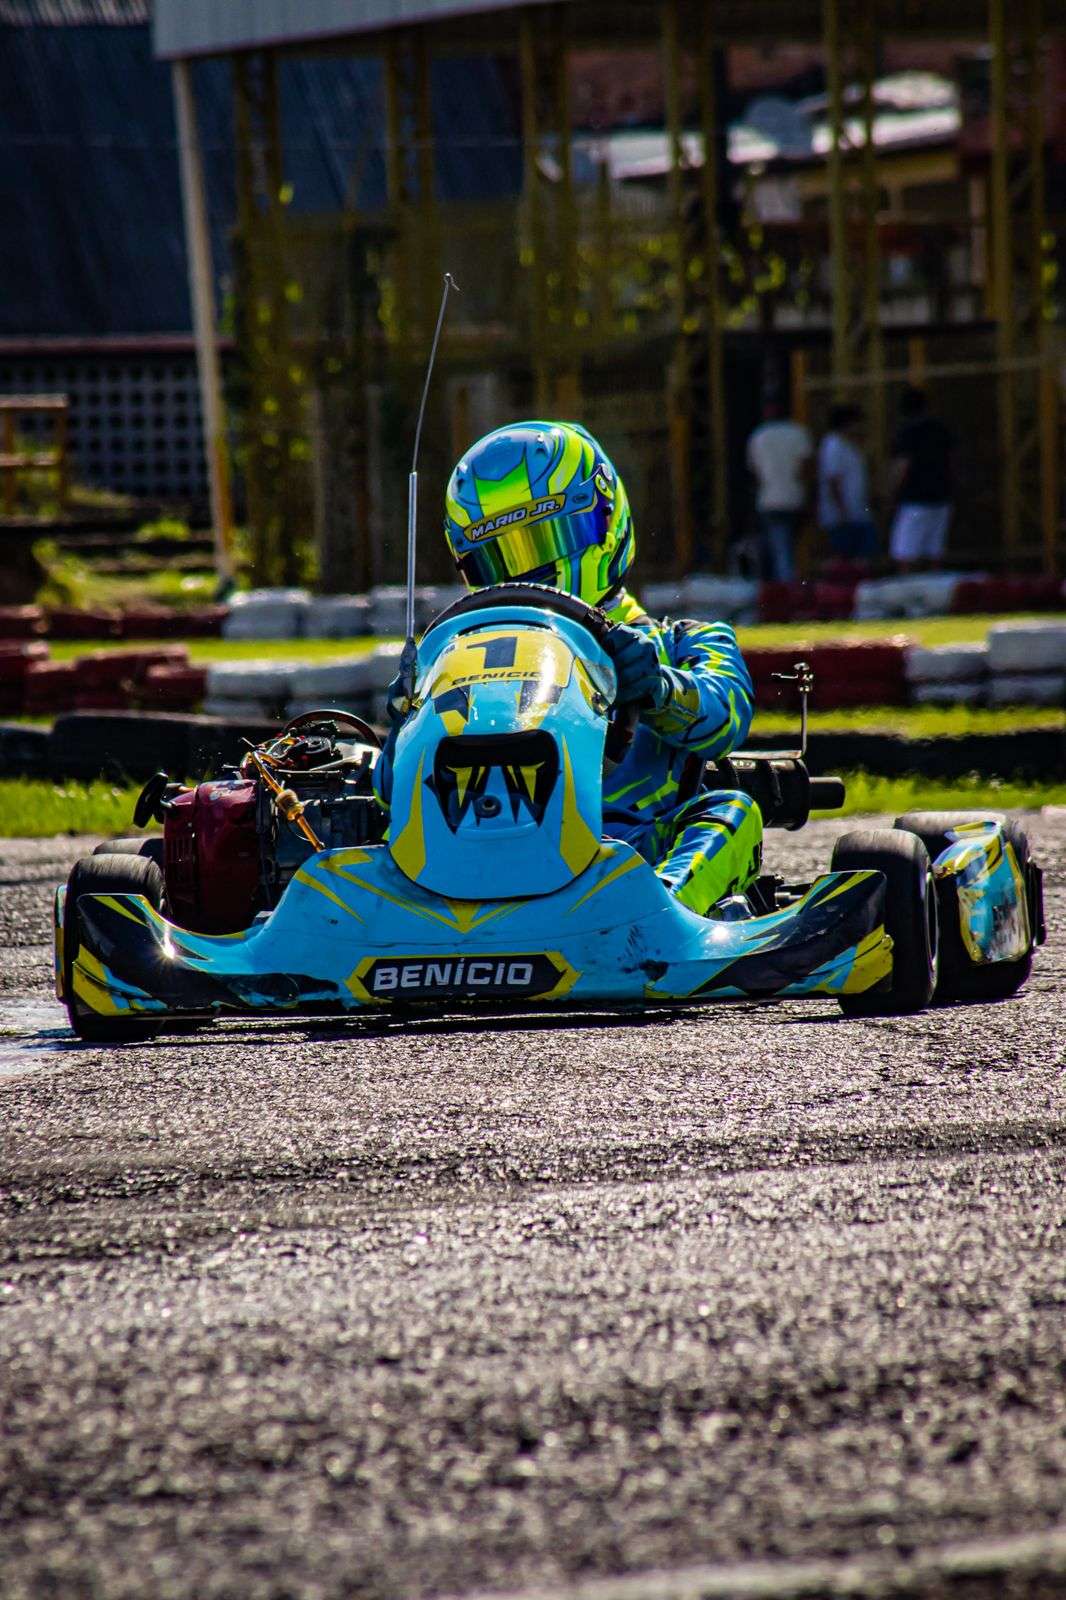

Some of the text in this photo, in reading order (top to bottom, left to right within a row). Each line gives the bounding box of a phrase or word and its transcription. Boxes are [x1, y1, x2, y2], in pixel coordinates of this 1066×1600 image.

[472, 500, 559, 539] MARIO JR.
[466, 636, 518, 669] 1
[373, 957, 533, 991] BENÍCIO
